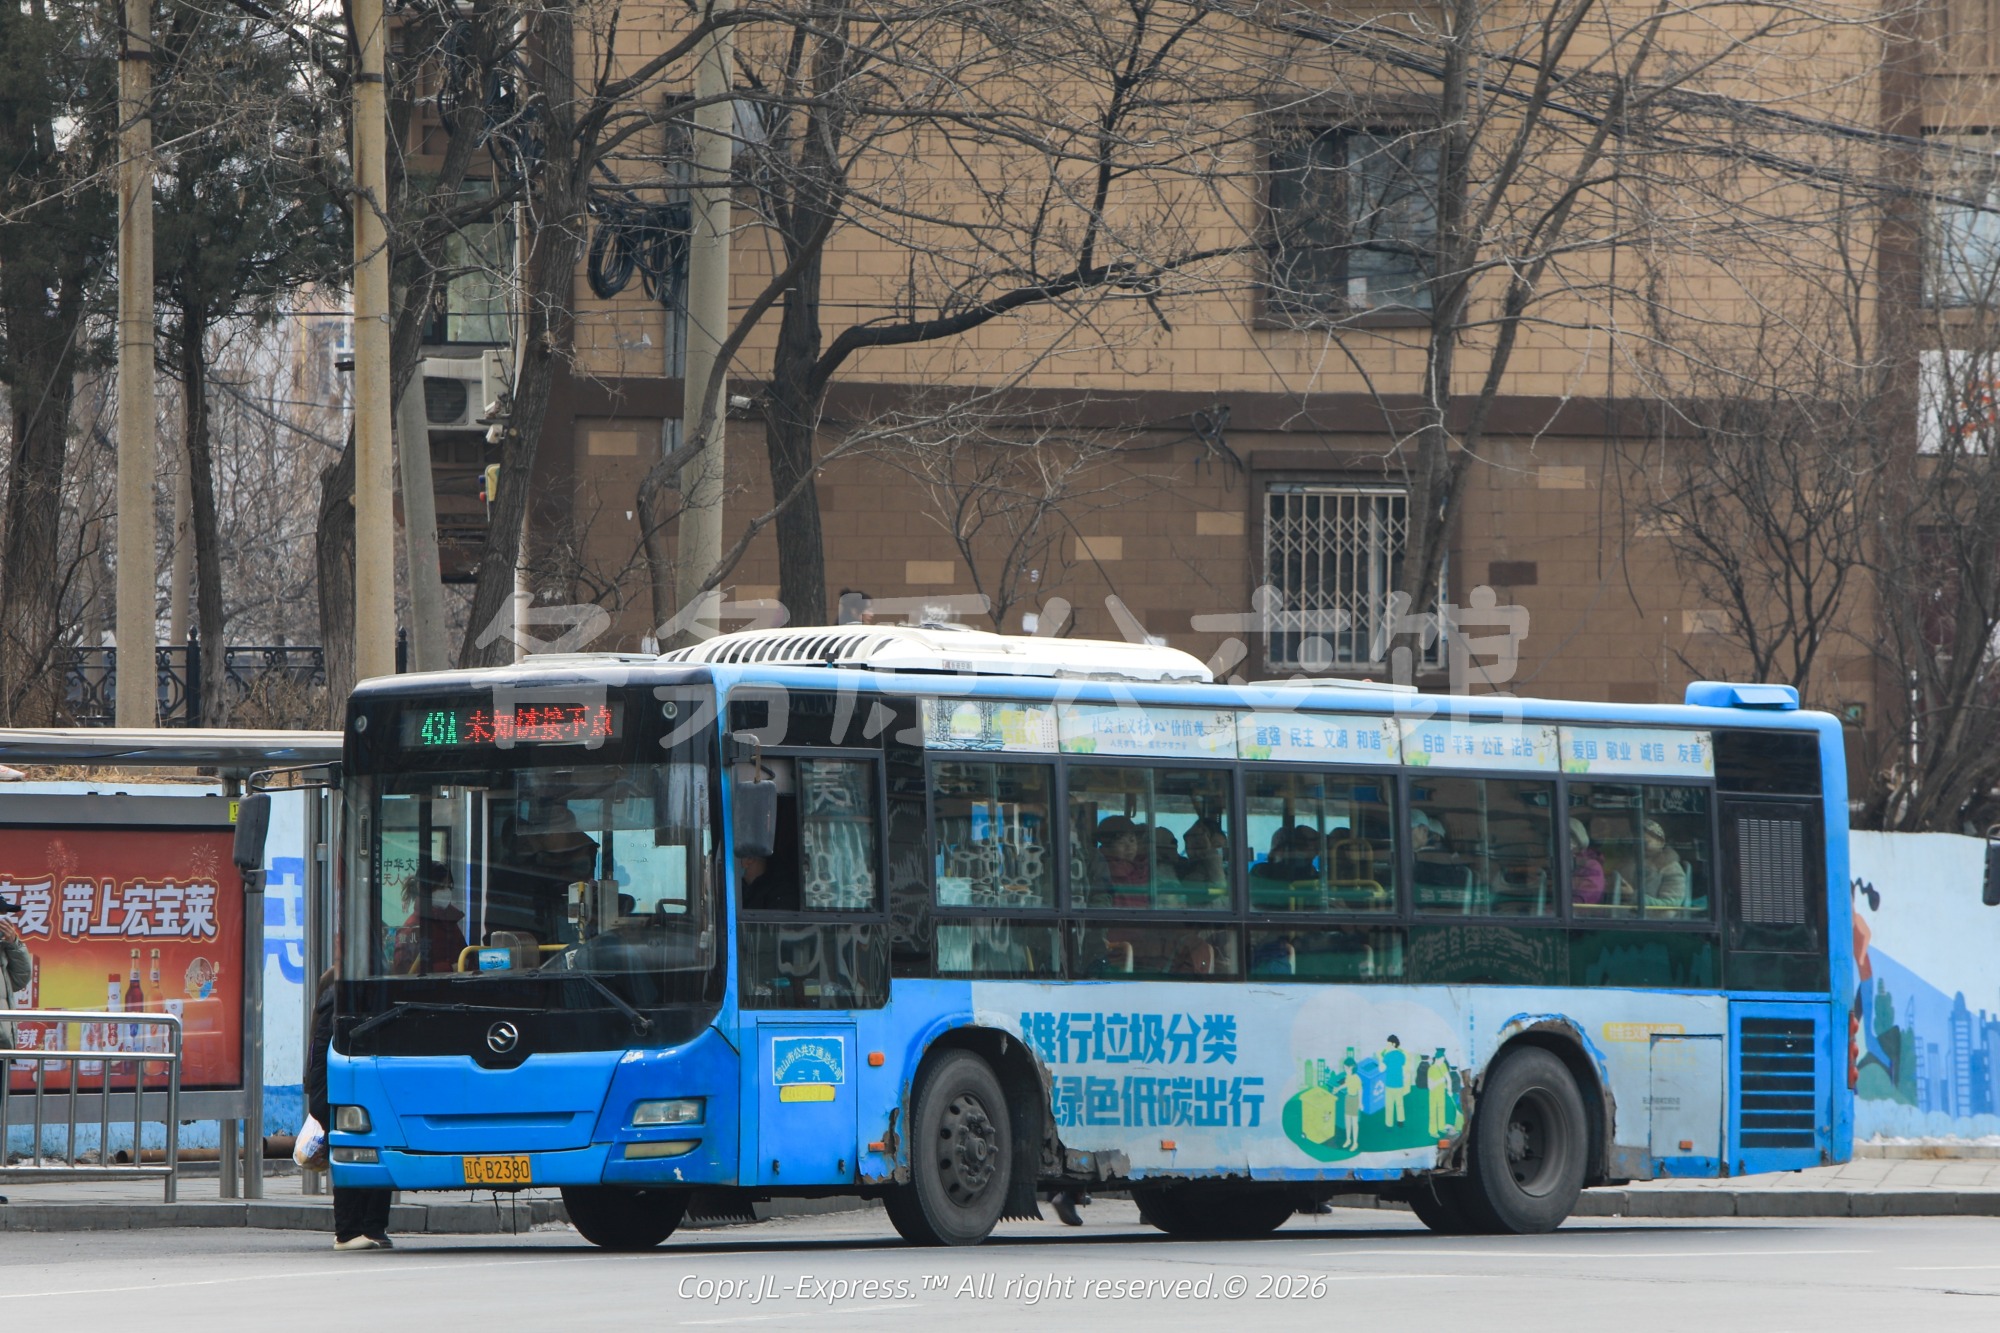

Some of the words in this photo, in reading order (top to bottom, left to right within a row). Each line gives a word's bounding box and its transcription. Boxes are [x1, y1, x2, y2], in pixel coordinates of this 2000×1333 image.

[421, 711, 458, 745] 43A
[1092, 715, 1206, 738] 社会主义核心价值观
[1256, 725, 1282, 747] 富强
[1290, 726, 1315, 747] 民主
[1323, 727, 1349, 748] 文明
[1356, 728, 1382, 751] 和谐
[1422, 733, 1445, 754] 自由
[1451, 734, 1475, 756] 平等
[1482, 734, 1504, 757] 公正
[1511, 736, 1533, 758] 法治
[1572, 739, 1598, 761] 爱国
[1606, 740, 1631, 762] 敬业
[1639, 741, 1665, 762] 诚信
[1677, 742, 1702, 764] 友善
[382, 872, 412, 886] 天人
[62, 882, 217, 937] 带上宏宝莱
[1020, 1012, 1238, 1065] 推行垃圾分类
[1051, 1075, 1265, 1127] 绿色低碳出行
